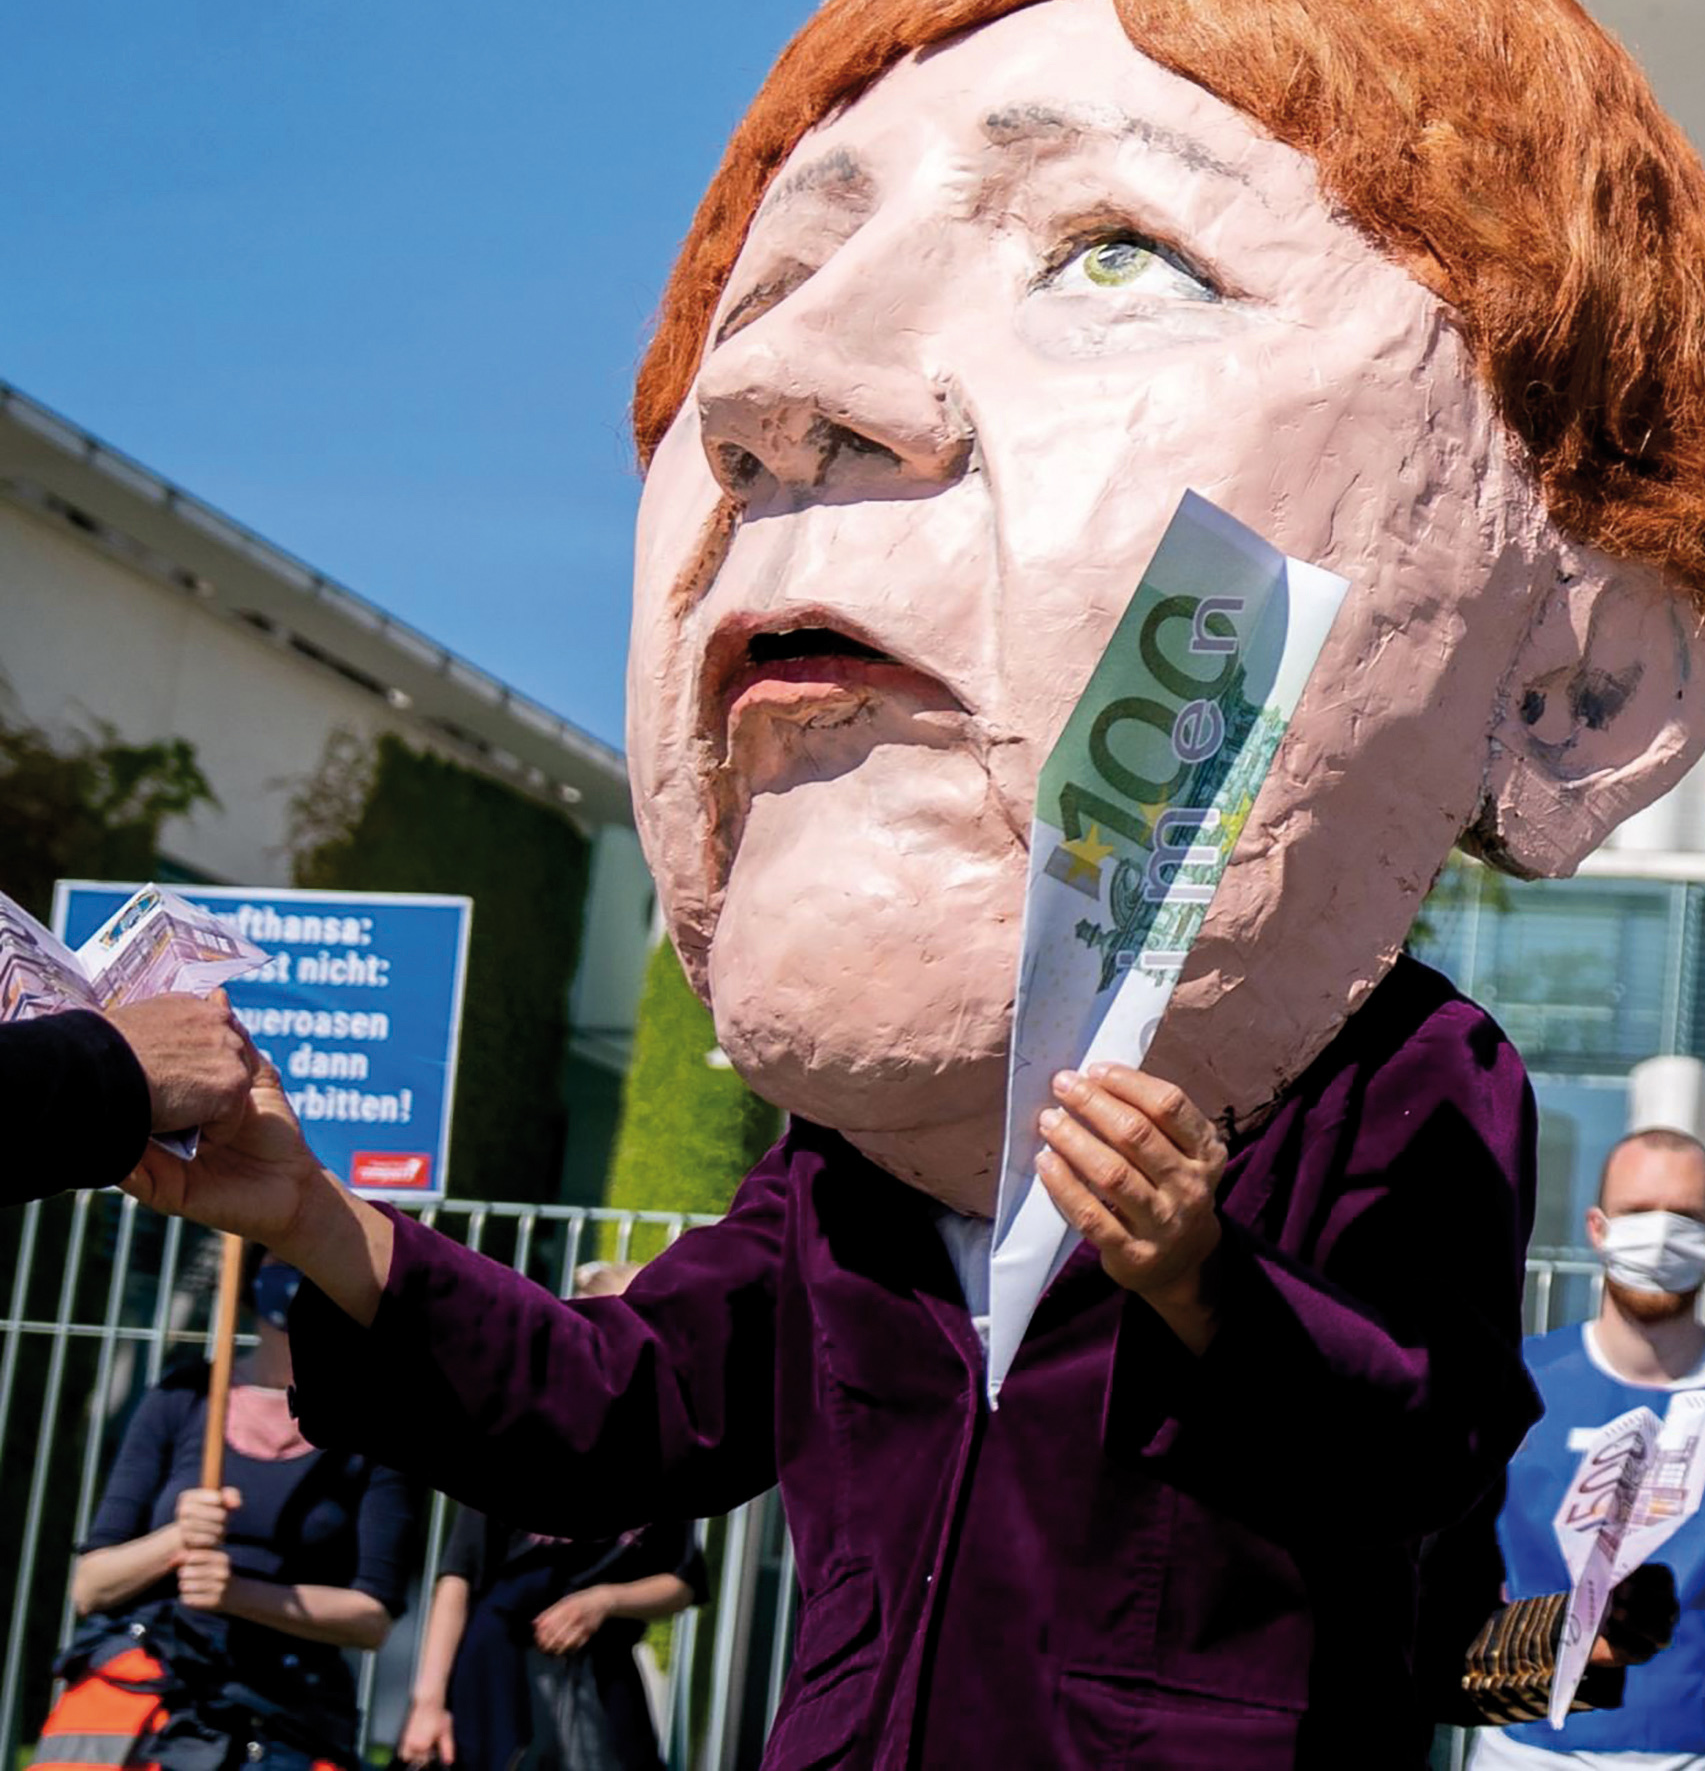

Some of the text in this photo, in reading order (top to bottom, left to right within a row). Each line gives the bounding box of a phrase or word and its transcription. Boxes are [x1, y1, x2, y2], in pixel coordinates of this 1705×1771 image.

[1059, 594, 1240, 846] 100
[297, 950, 390, 986] nicht:
[289, 1043, 368, 1079] dann
[287, 1084, 412, 1122] rbitten!
